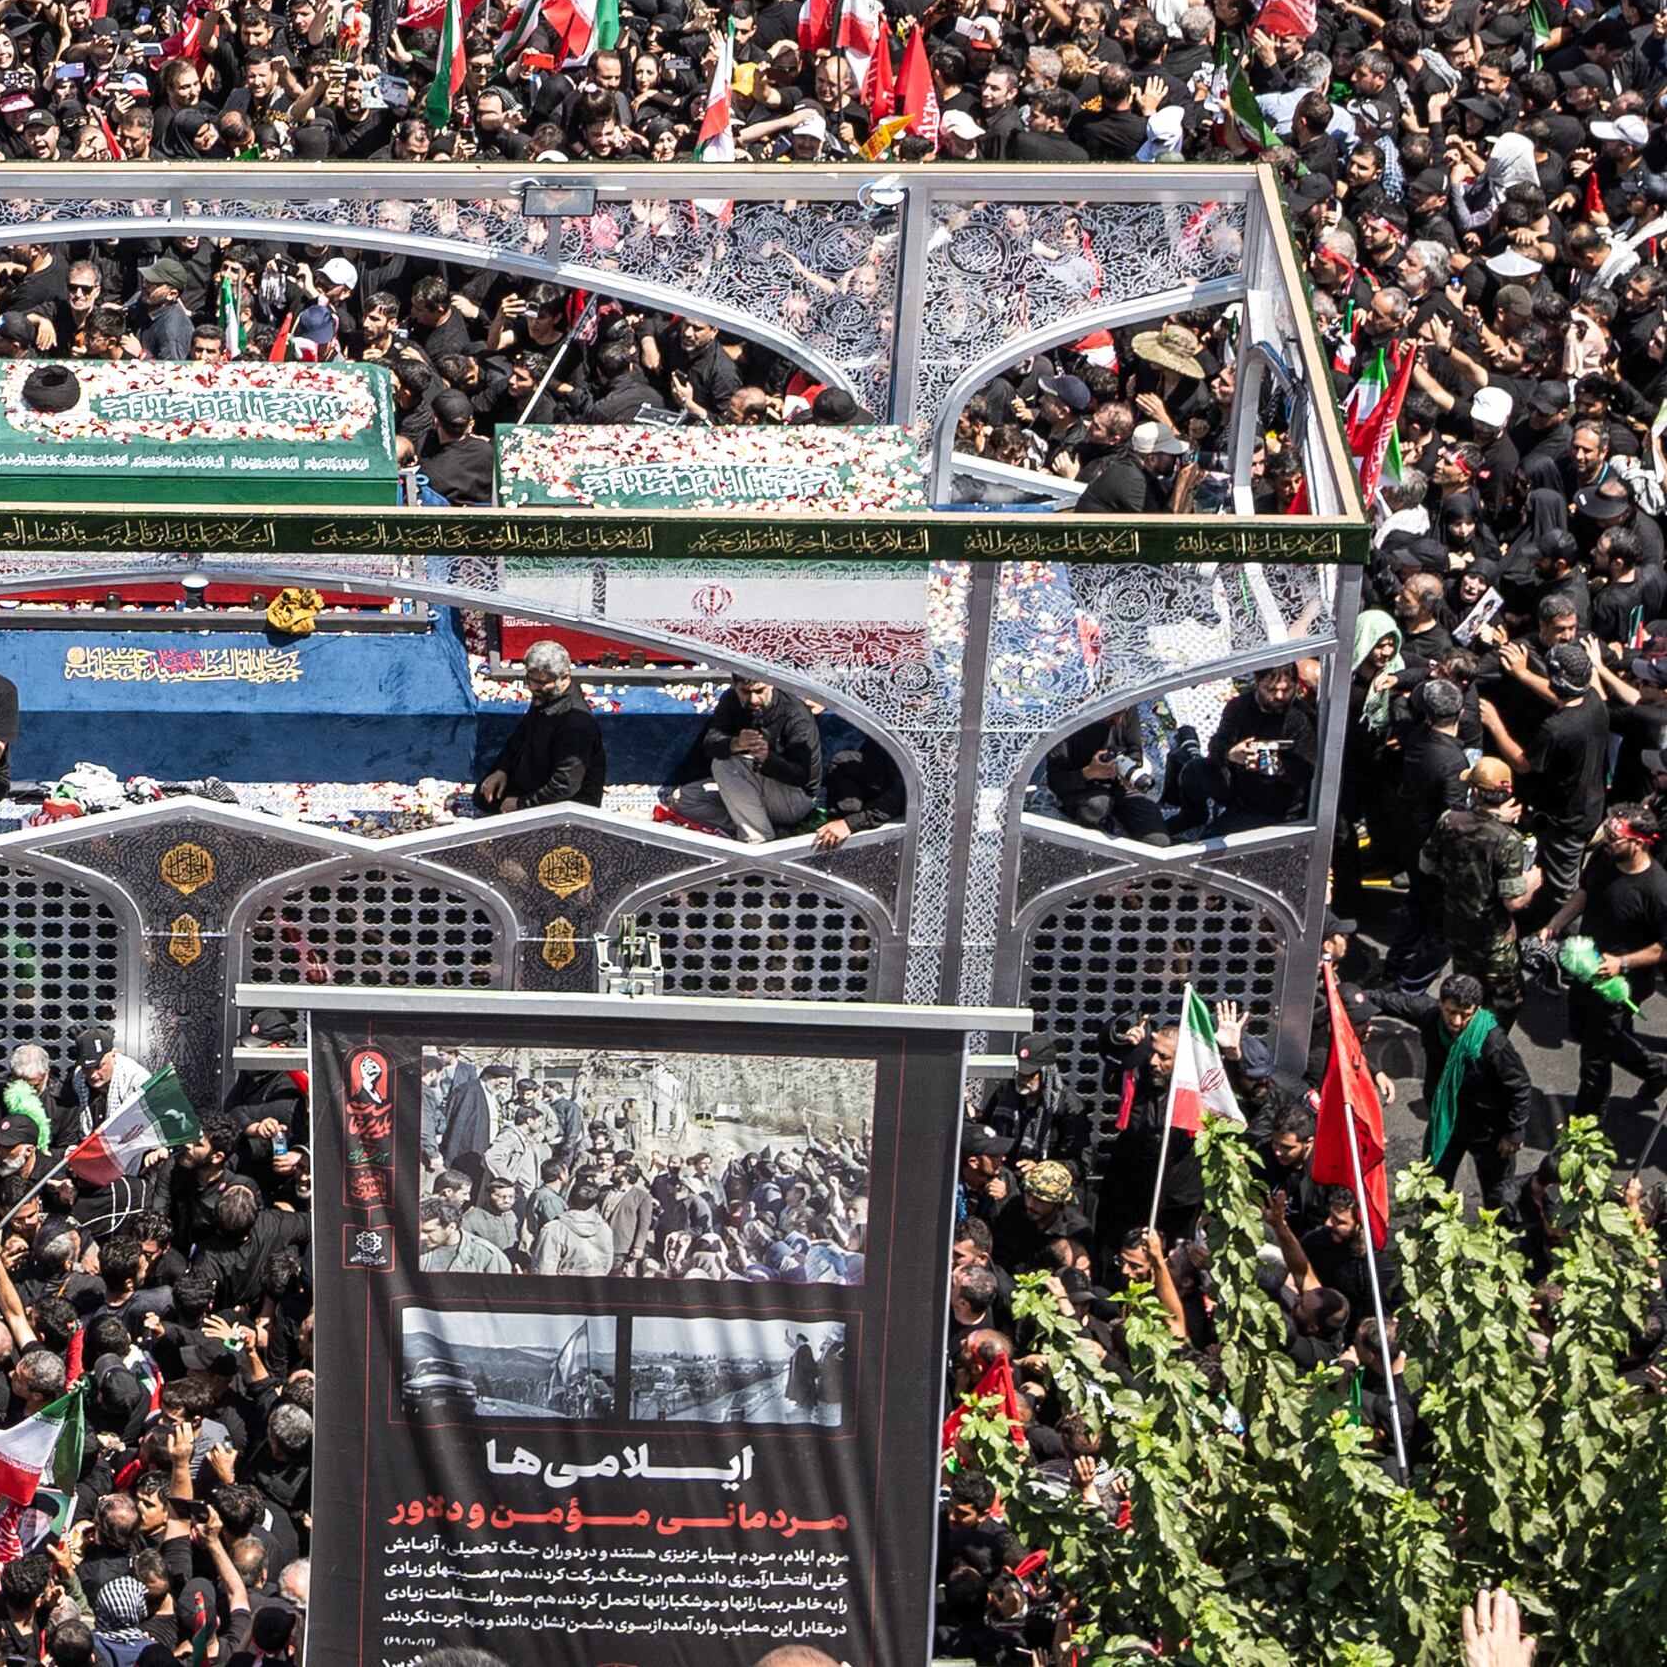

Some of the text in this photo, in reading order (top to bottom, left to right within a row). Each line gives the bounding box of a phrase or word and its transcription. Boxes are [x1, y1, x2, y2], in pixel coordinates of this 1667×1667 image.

[387, 1493, 849, 1538] مردمانی مؤمن و دلاور
[383, 1533, 441, 1555] آزمایش
[500, 1539, 540, 1560] جنگ
[542, 1543, 582, 1561] دوران
[582, 1547, 598, 1561] در
[598, 1551, 608, 1561] و
[610, 1547, 656, 1559] هستند
[658, 1550, 699, 1563] عزیزی
[701, 1546, 737, 1565] بسیار
[739, 1550, 777, 1566] مردم
[817, 1551, 850, 1568] مردم
[383, 1560, 423, 1579] زیادی
[500, 1567, 523, 1584] هم
[565, 1567, 609, 1583] شرکت
[609, 1566, 649, 1584] جنگ
[648, 1573, 663, 1587] در
[663, 1575, 686, 1589] هم
[727, 1569, 812, 1589] افتخارآمیزی
[812, 1575, 849, 1591] خیلی
[384, 1585, 424, 1602] زیادی
[424, 1586, 494, 1605] استقامت
[492, 1594, 504, 1607] و
[503, 1593, 534, 1607] صبر
[533, 1594, 556, 1609] هم
[598, 1593, 642, 1611] تحمل
[643, 1593, 720, 1611] موشکبارانها
[719, 1599, 729, 1612] و
[729, 1593, 784, 1614] بمبارانها
[785, 1596, 823, 1612] خاطر
[823, 1599, 839, 1614] به
[839, 1596, 849, 1614] را
[431, 1611, 485, 1629] مهاجرت
[484, 1617, 495, 1630] و
[495, 1612, 530, 1628] دادند
[530, 1612, 566, 1630] نشان
[566, 1615, 614, 1633] دشمن
[614, 1619, 652, 1634] سوی
[651, 1617, 663, 1633] از
[662, 1615, 693, 1633] آمده
[692, 1617, 718, 1634] وارد
[770, 1619, 793, 1638] این
[793, 1621, 834, 1639] مقابل
[833, 1624, 847, 1638] در
